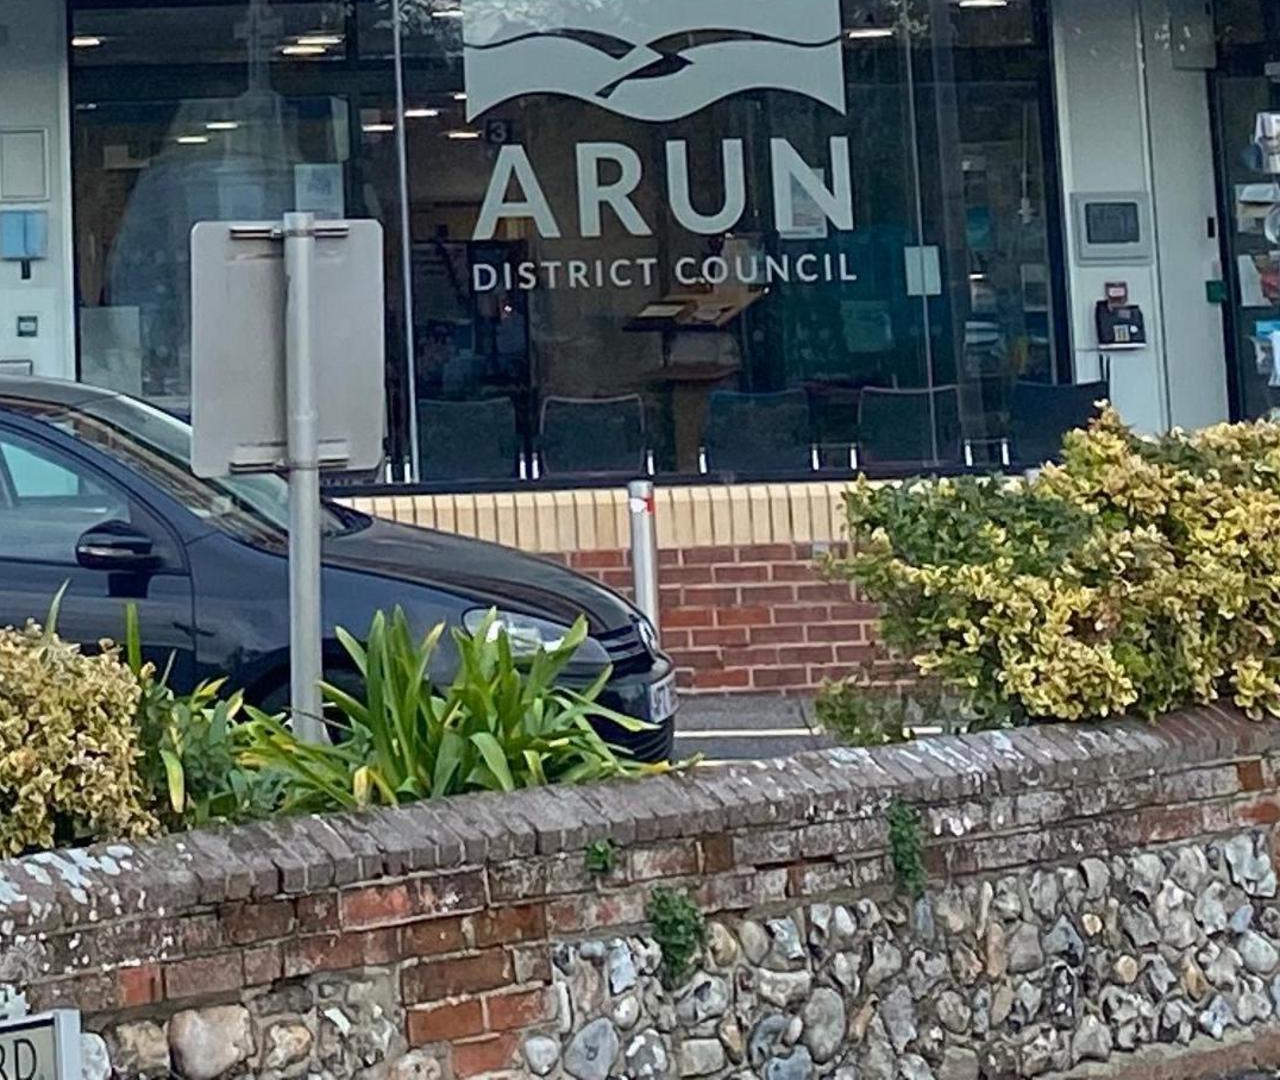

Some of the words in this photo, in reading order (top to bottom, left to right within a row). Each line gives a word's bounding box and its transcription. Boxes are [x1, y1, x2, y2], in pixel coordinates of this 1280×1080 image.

[471, 136, 854, 240] ARUN
[472, 257, 658, 292] DISTRICT
[674, 252, 857, 286] COUNCIL
